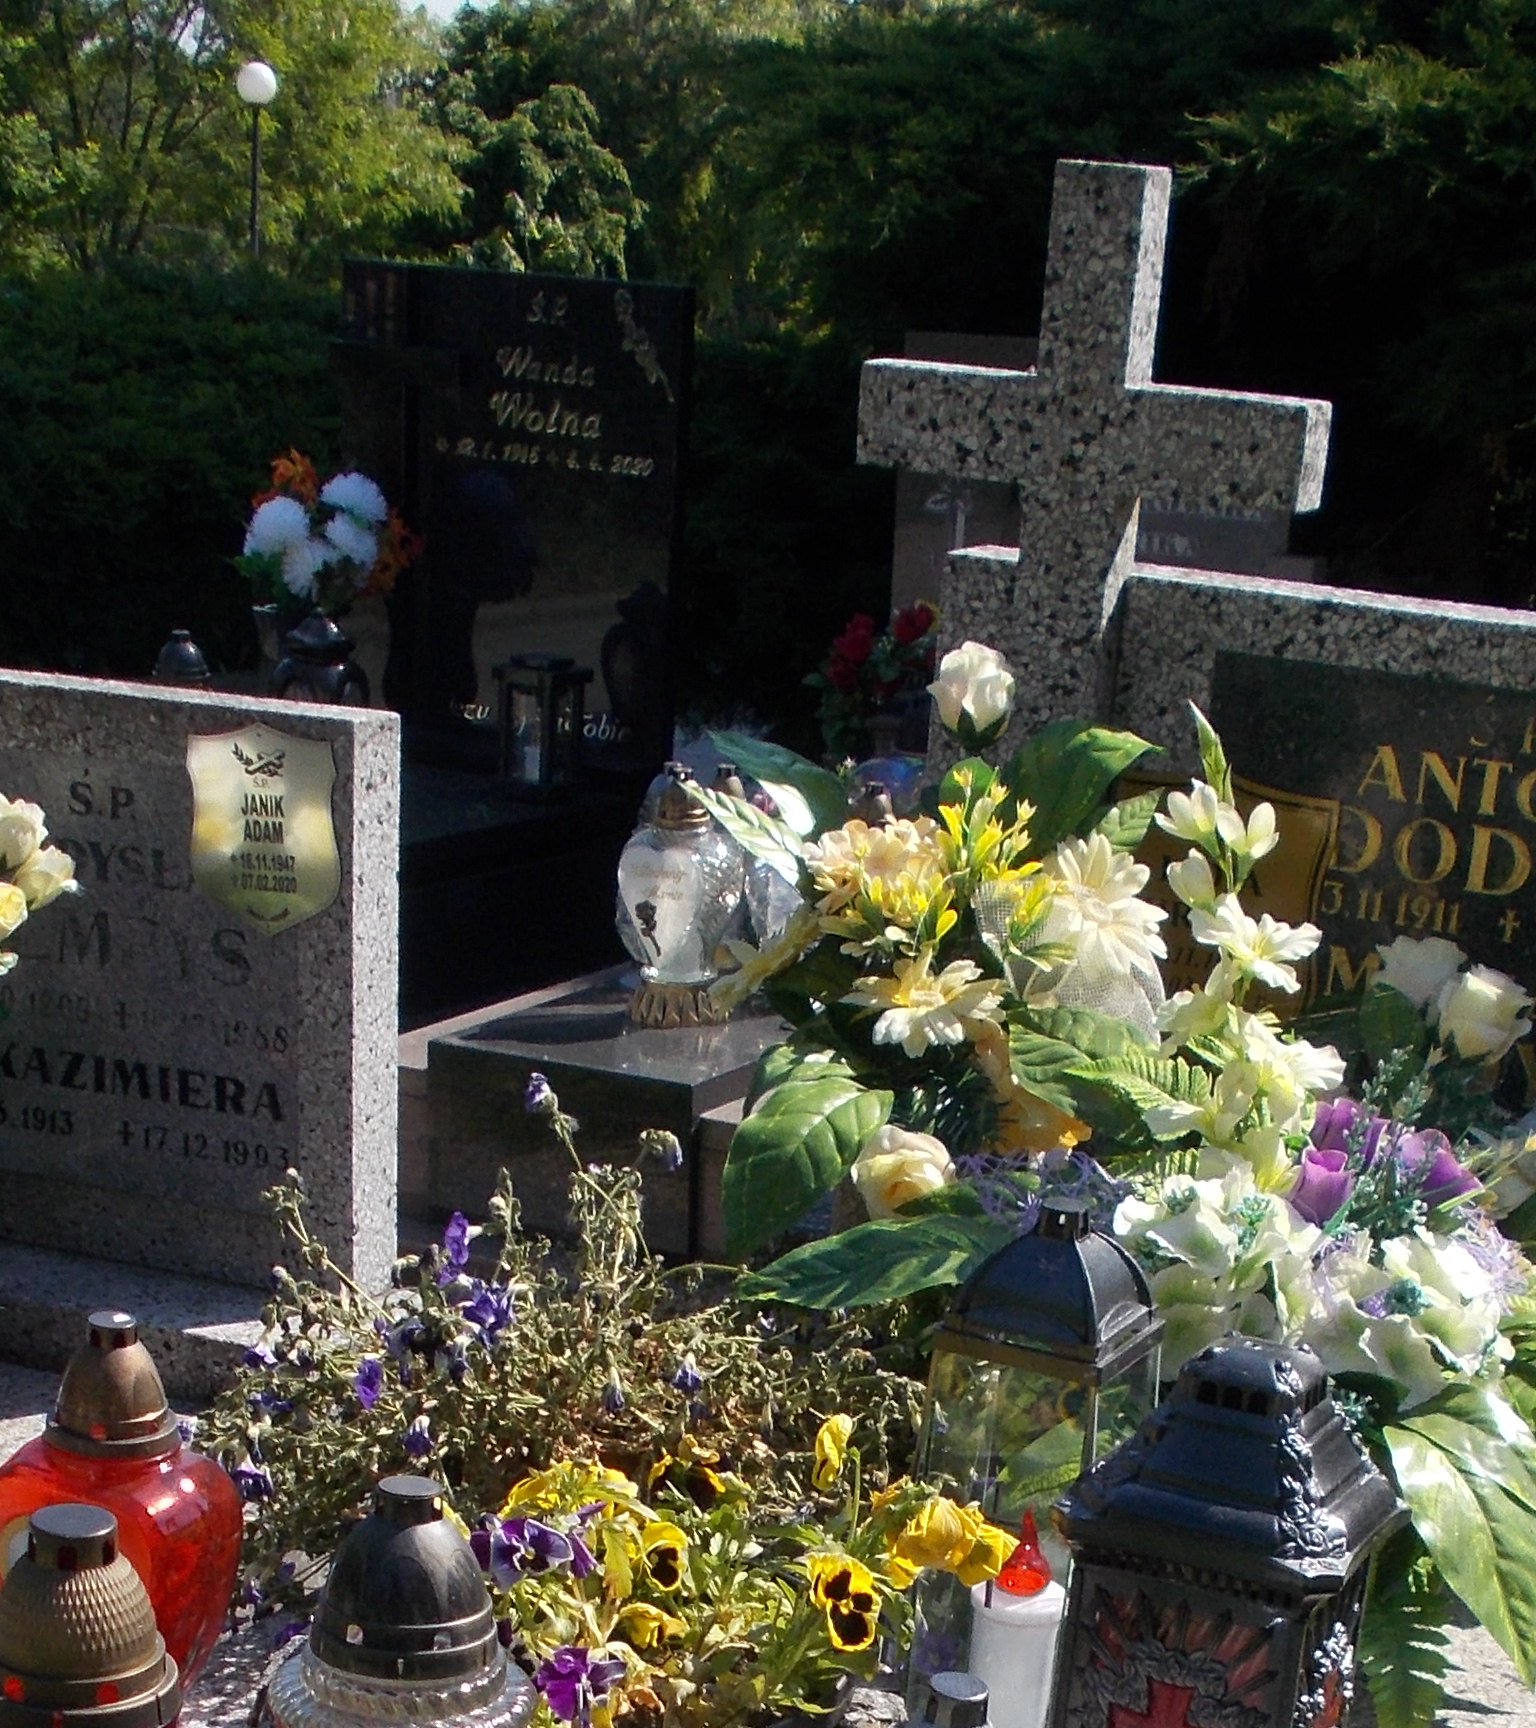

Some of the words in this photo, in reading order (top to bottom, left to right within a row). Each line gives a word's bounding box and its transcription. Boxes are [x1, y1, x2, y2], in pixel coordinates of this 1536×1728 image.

[494, 343, 597, 388] Wanda
[487, 389, 603, 441] Wolna
[240, 793, 285, 819] JANIK
[243, 819, 285, 845] ADAM
